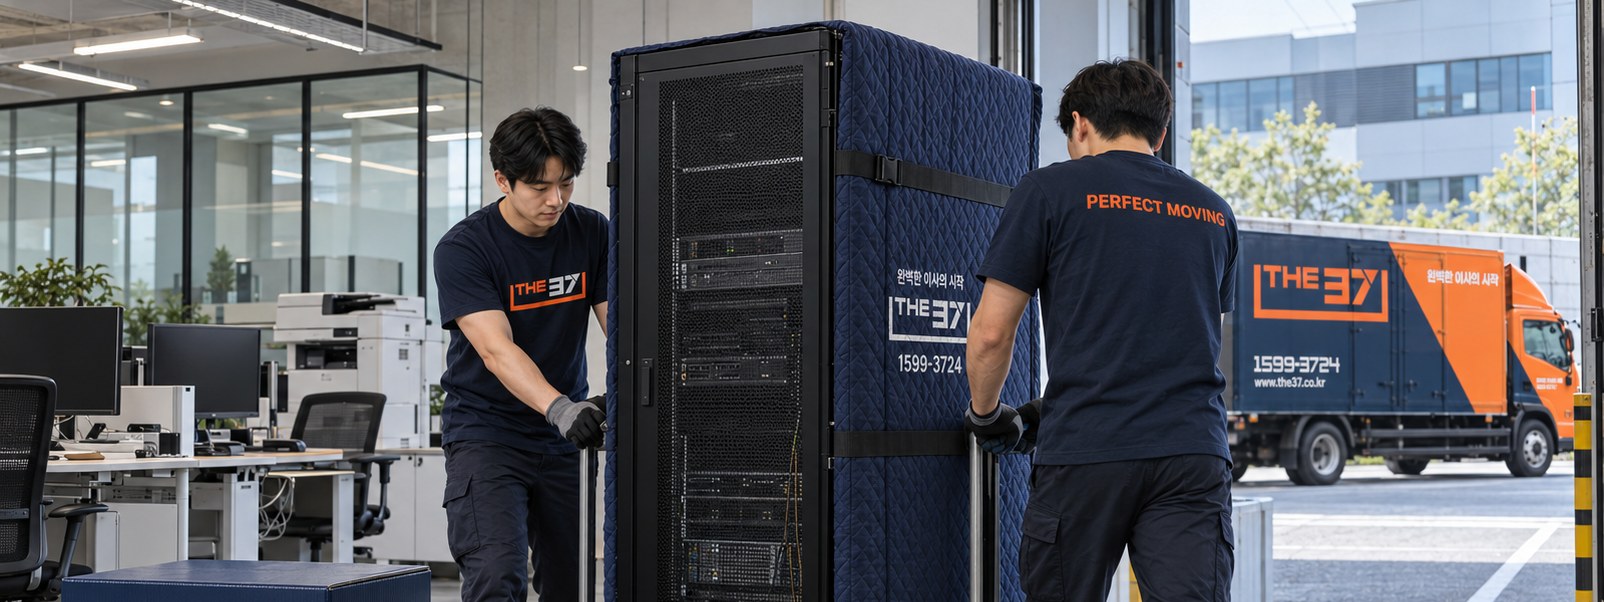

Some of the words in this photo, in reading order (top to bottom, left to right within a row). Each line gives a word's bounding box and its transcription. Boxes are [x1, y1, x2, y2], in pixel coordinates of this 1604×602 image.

[1086, 194, 1162, 214] PERFECT
[1166, 202, 1225, 227] MOVING
[515, 279, 547, 296] THE
[549, 272, 581, 297] 37
[923, 271, 947, 289] 이사의
[949, 273, 964, 291] 시작
[1263, 264, 1319, 290] THE
[1324, 267, 1379, 306] 37
[1455, 271, 1480, 286] 이사의
[894, 296, 930, 317] THE
[932, 299, 965, 329] 37
[898, 354, 962, 374] 1599-3724
[1253, 355, 1340, 374] 1599-3724
[1254, 376, 1326, 388] www.the37.co.kr
